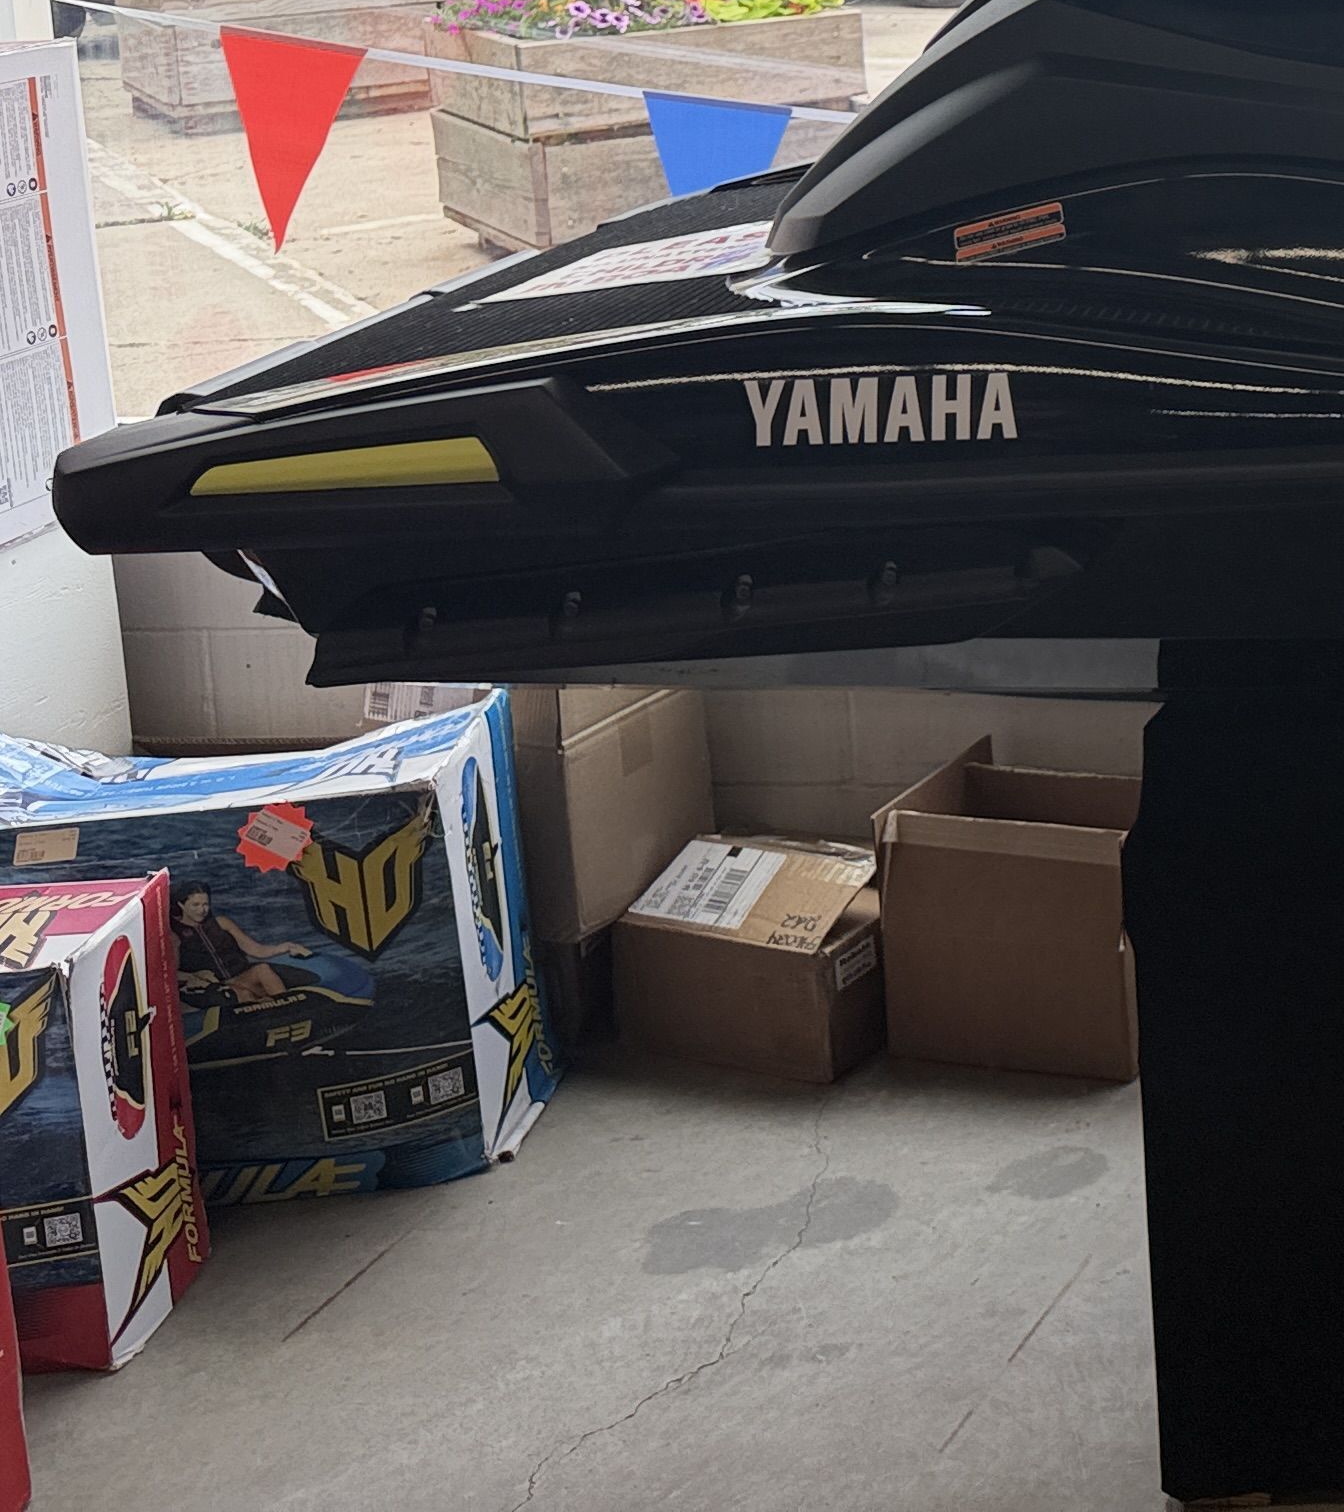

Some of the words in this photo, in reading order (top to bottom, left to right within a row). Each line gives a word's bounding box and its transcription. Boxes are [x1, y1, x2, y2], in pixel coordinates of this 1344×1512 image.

[743, 372, 1018, 447] YAMAHA
[294, 815, 431, 952] HO
[172, 1114, 203, 1263] FORMULA
